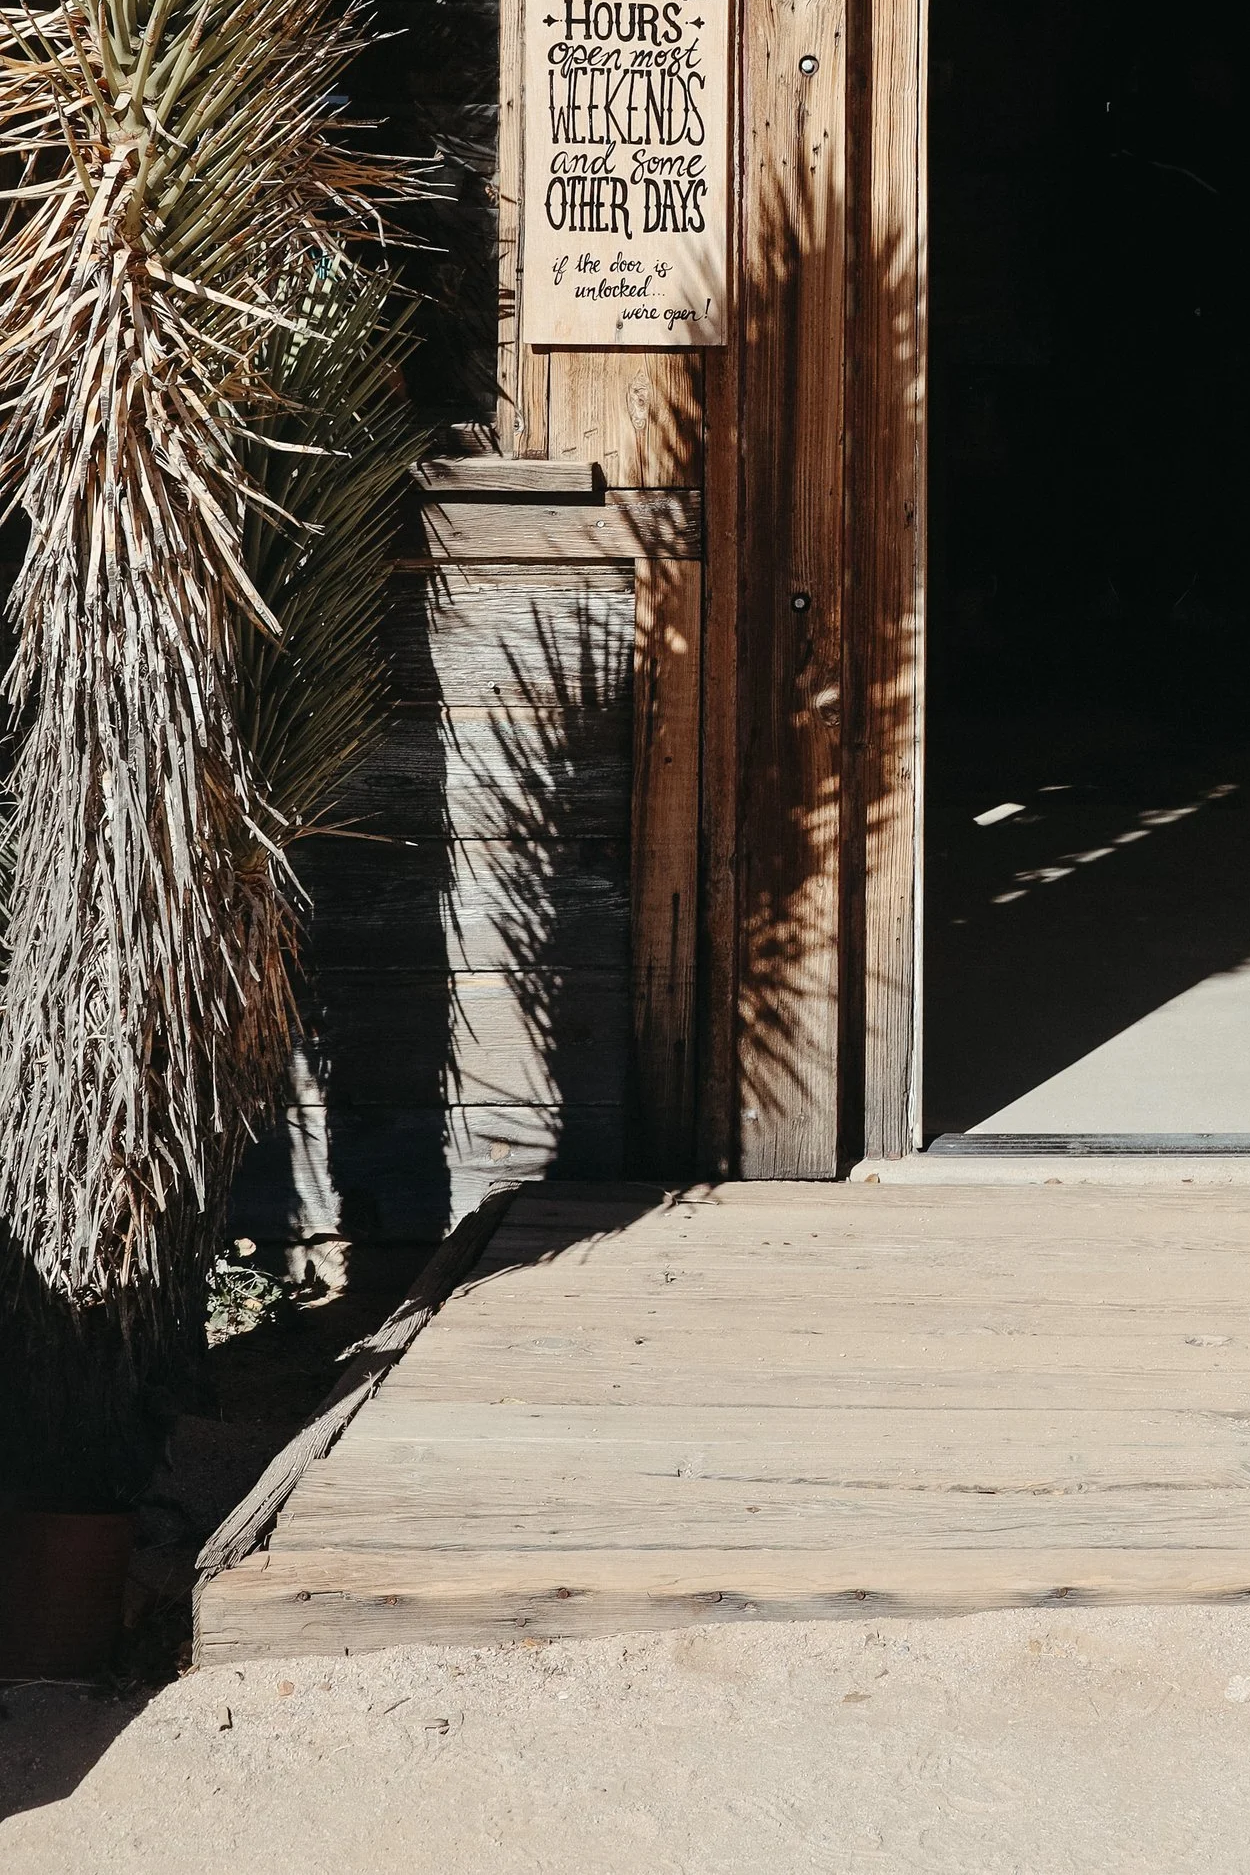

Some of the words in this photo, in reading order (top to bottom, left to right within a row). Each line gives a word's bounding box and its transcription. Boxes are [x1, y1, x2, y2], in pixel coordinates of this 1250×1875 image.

[547, 41, 622, 79] open
[629, 37, 702, 78] most
[548, 68, 706, 146] WEEKENDS
[550, 140, 617, 175] and
[630, 148, 707, 185] some
[544, 176, 633, 240] OTHER
[642, 178, 708, 233] DAYS
[552, 255, 569, 285] if
[574, 253, 601, 274] the
[609, 251, 645, 274] door
[653, 259, 673, 278] is
[622, 303, 660, 321] we're
